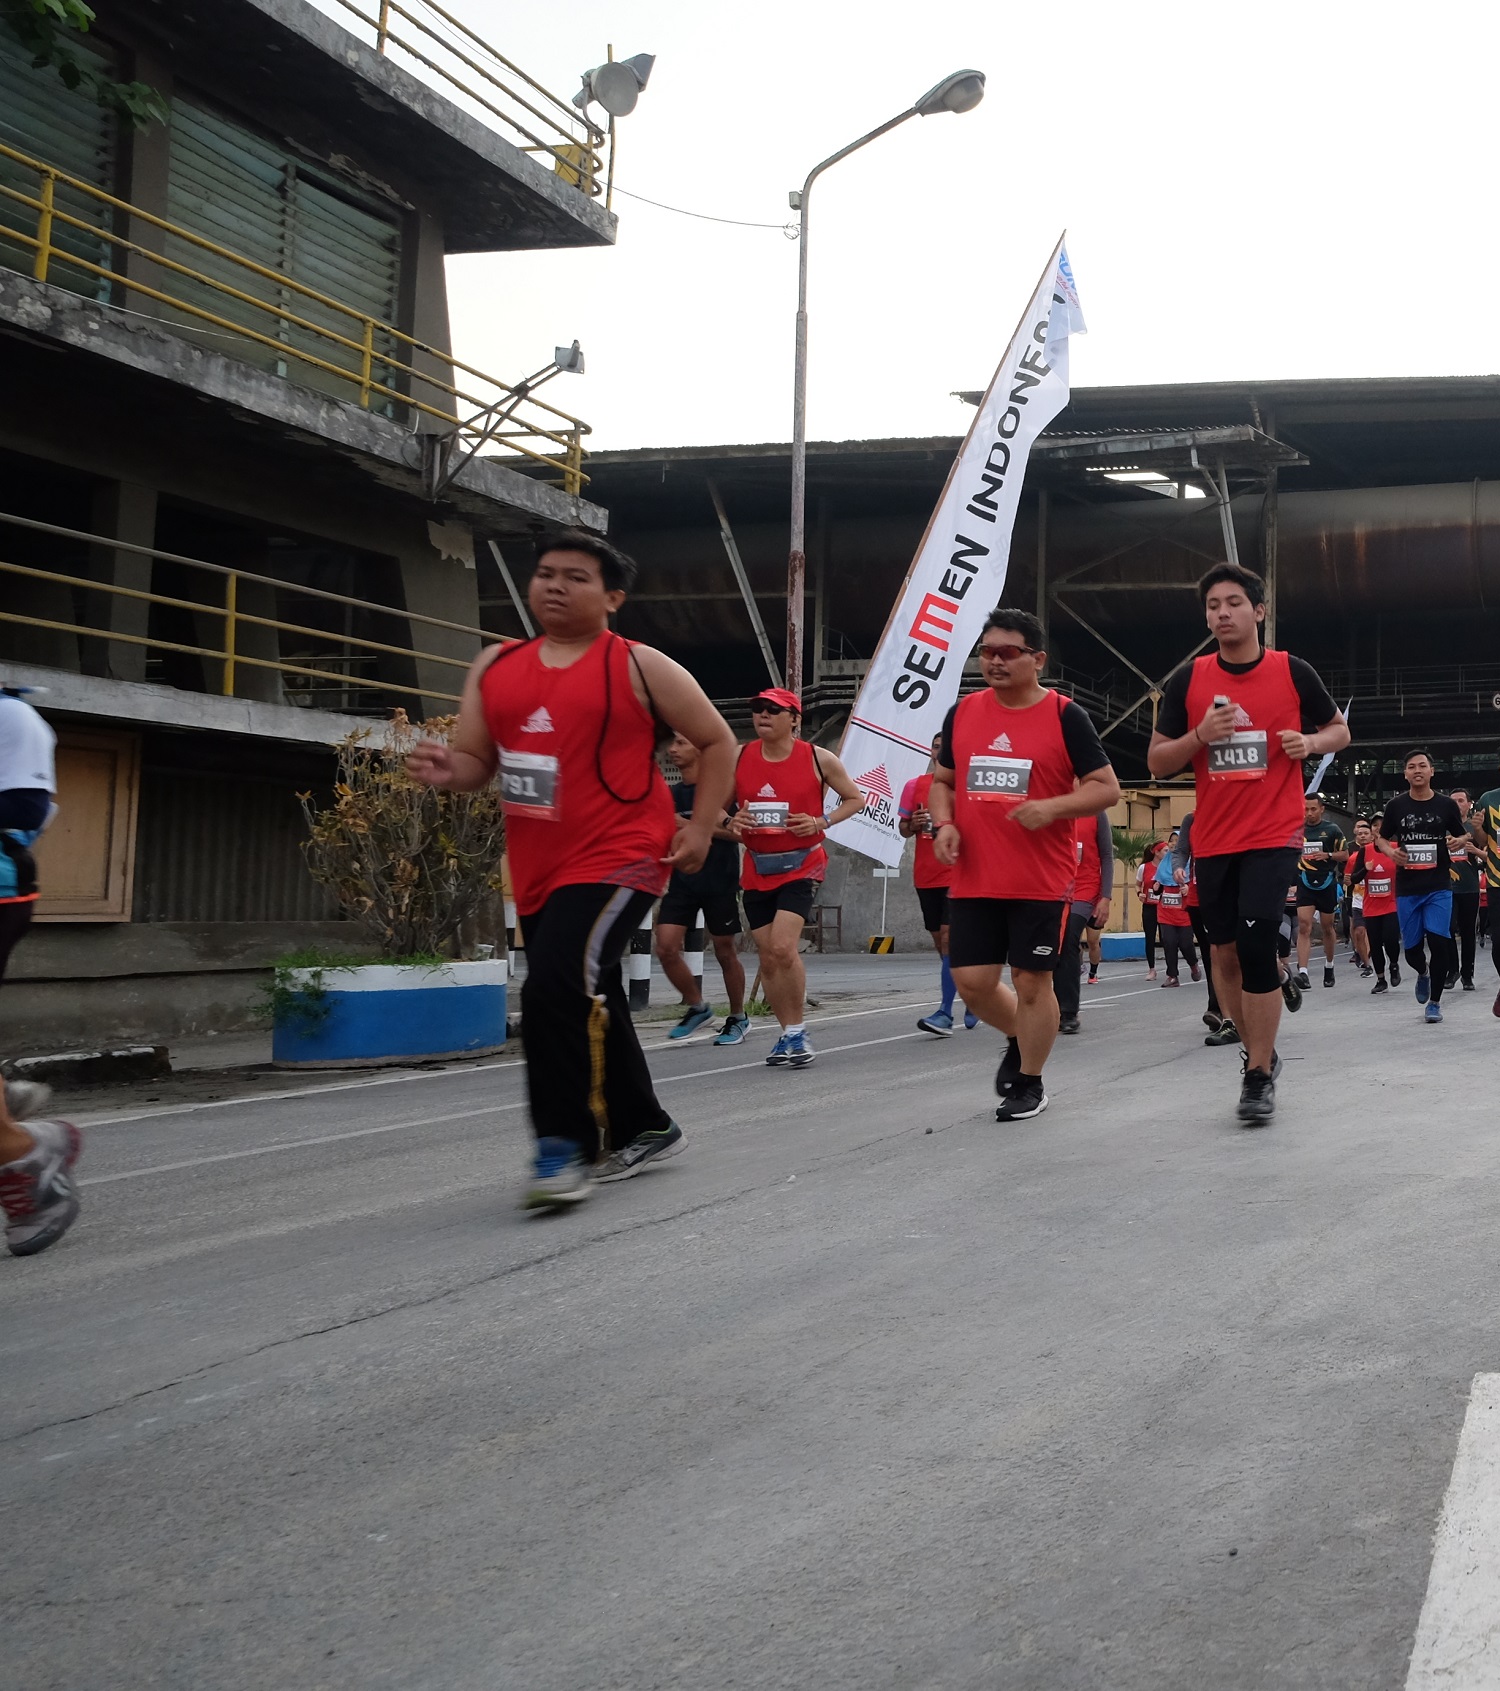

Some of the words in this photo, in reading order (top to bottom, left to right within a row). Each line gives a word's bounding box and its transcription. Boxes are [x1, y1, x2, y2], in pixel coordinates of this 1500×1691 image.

[892, 533, 990, 710] SEMEN
[1214, 747, 1259, 766] 1418
[974, 771, 1019, 788] 1393
[752, 812, 781, 824] 263
[1408, 852, 1433, 862] 1785
